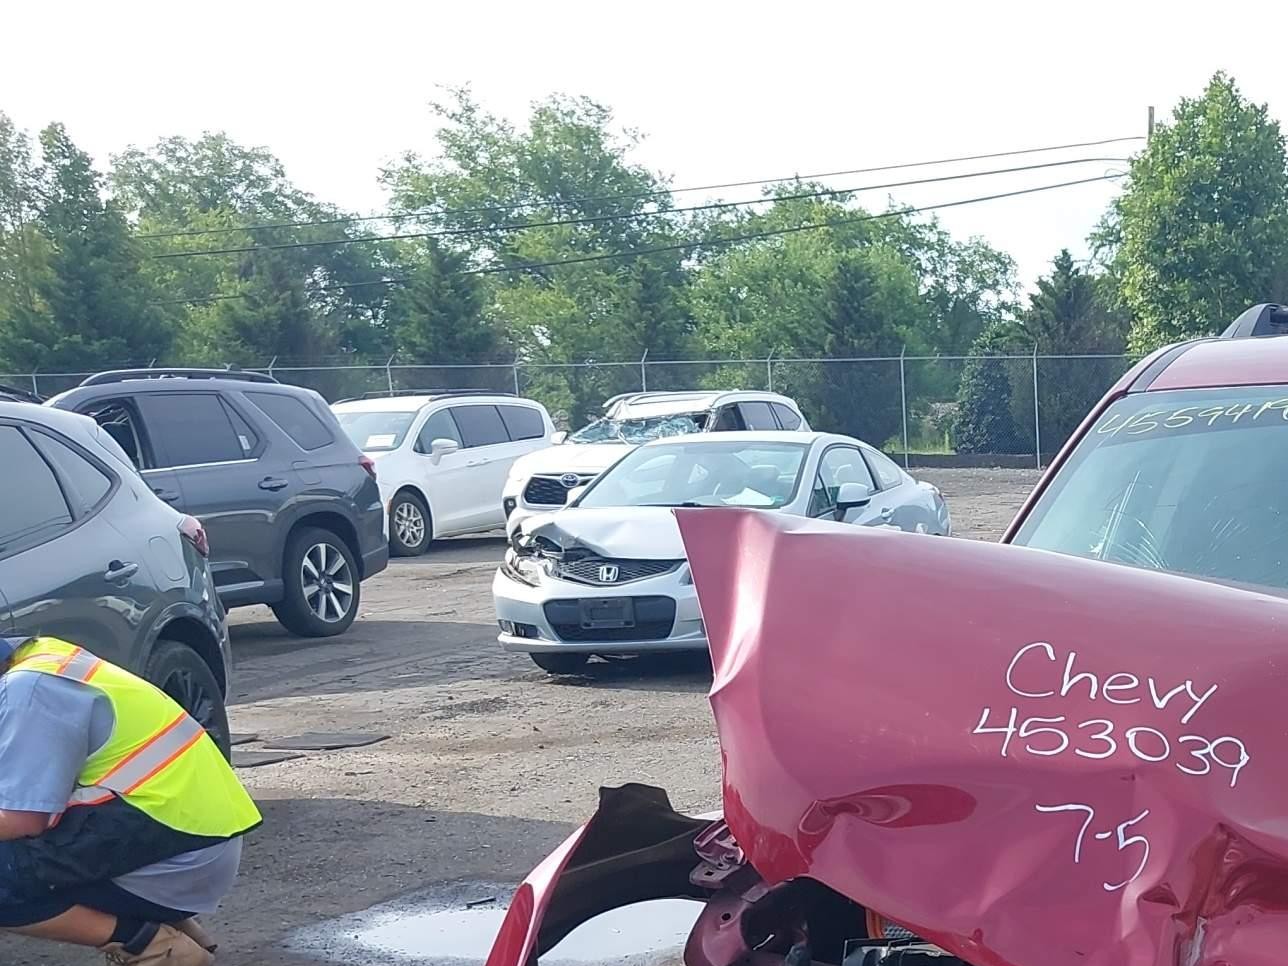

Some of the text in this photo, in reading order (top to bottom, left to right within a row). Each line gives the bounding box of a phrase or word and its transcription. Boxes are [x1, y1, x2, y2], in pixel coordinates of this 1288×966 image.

[1006, 642, 1218, 724] Chevy
[972, 707, 1250, 787] 453039
[1035, 803, 1150, 891] 7-5
